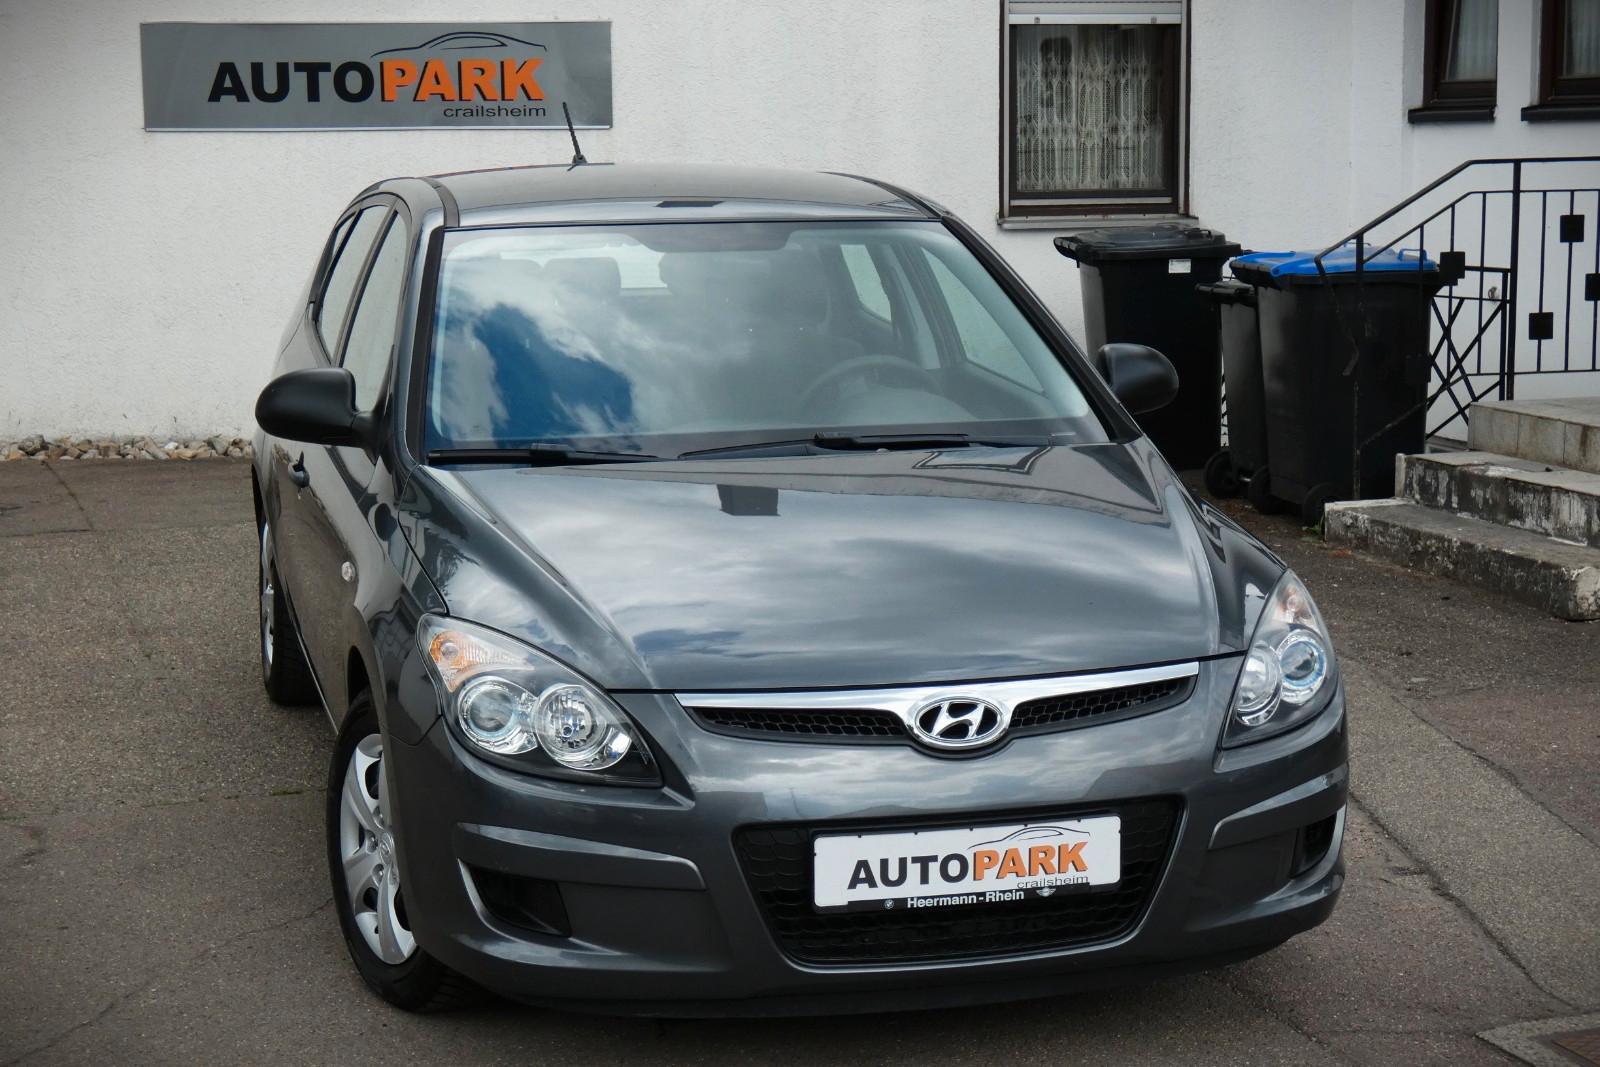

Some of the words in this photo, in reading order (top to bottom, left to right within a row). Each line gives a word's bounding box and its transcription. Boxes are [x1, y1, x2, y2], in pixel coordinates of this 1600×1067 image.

[207, 58, 545, 103] AUTOPARK
[443, 104, 547, 118] crailsheim
[847, 841, 1089, 890] AUTOPARK
[1016, 875, 1089, 889] crailsheim
